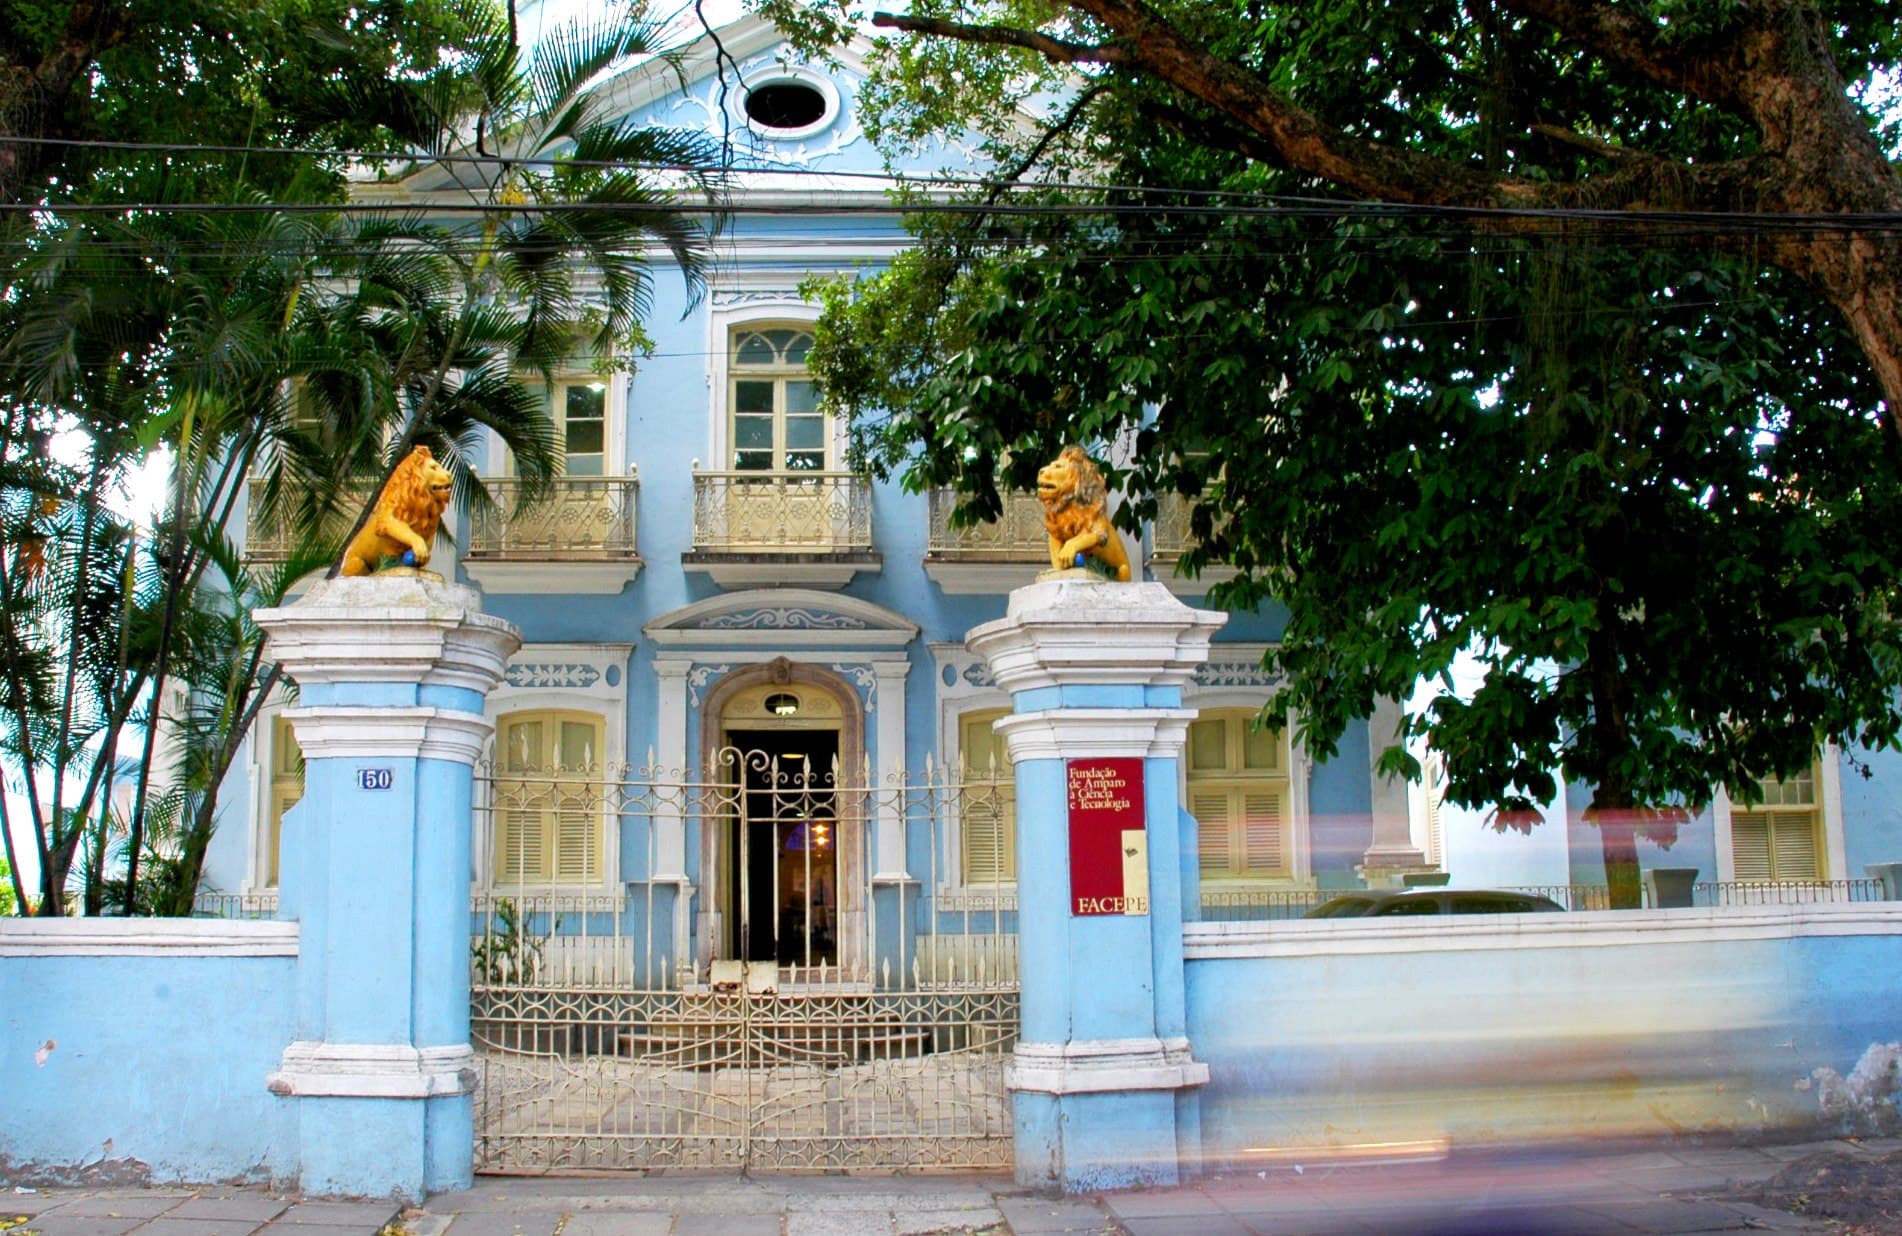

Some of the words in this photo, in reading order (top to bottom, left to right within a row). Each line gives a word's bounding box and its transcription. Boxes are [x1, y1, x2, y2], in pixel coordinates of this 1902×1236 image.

[358, 770, 389, 788] 150
[1069, 767, 1117, 780] Fundação
[1069, 778, 1081, 789] de
[1084, 778, 1126, 791] Amparo
[1070, 801, 1076, 809] e
[1079, 797, 1131, 812] Tecnologia
[1078, 896, 1148, 914] FACEPE
